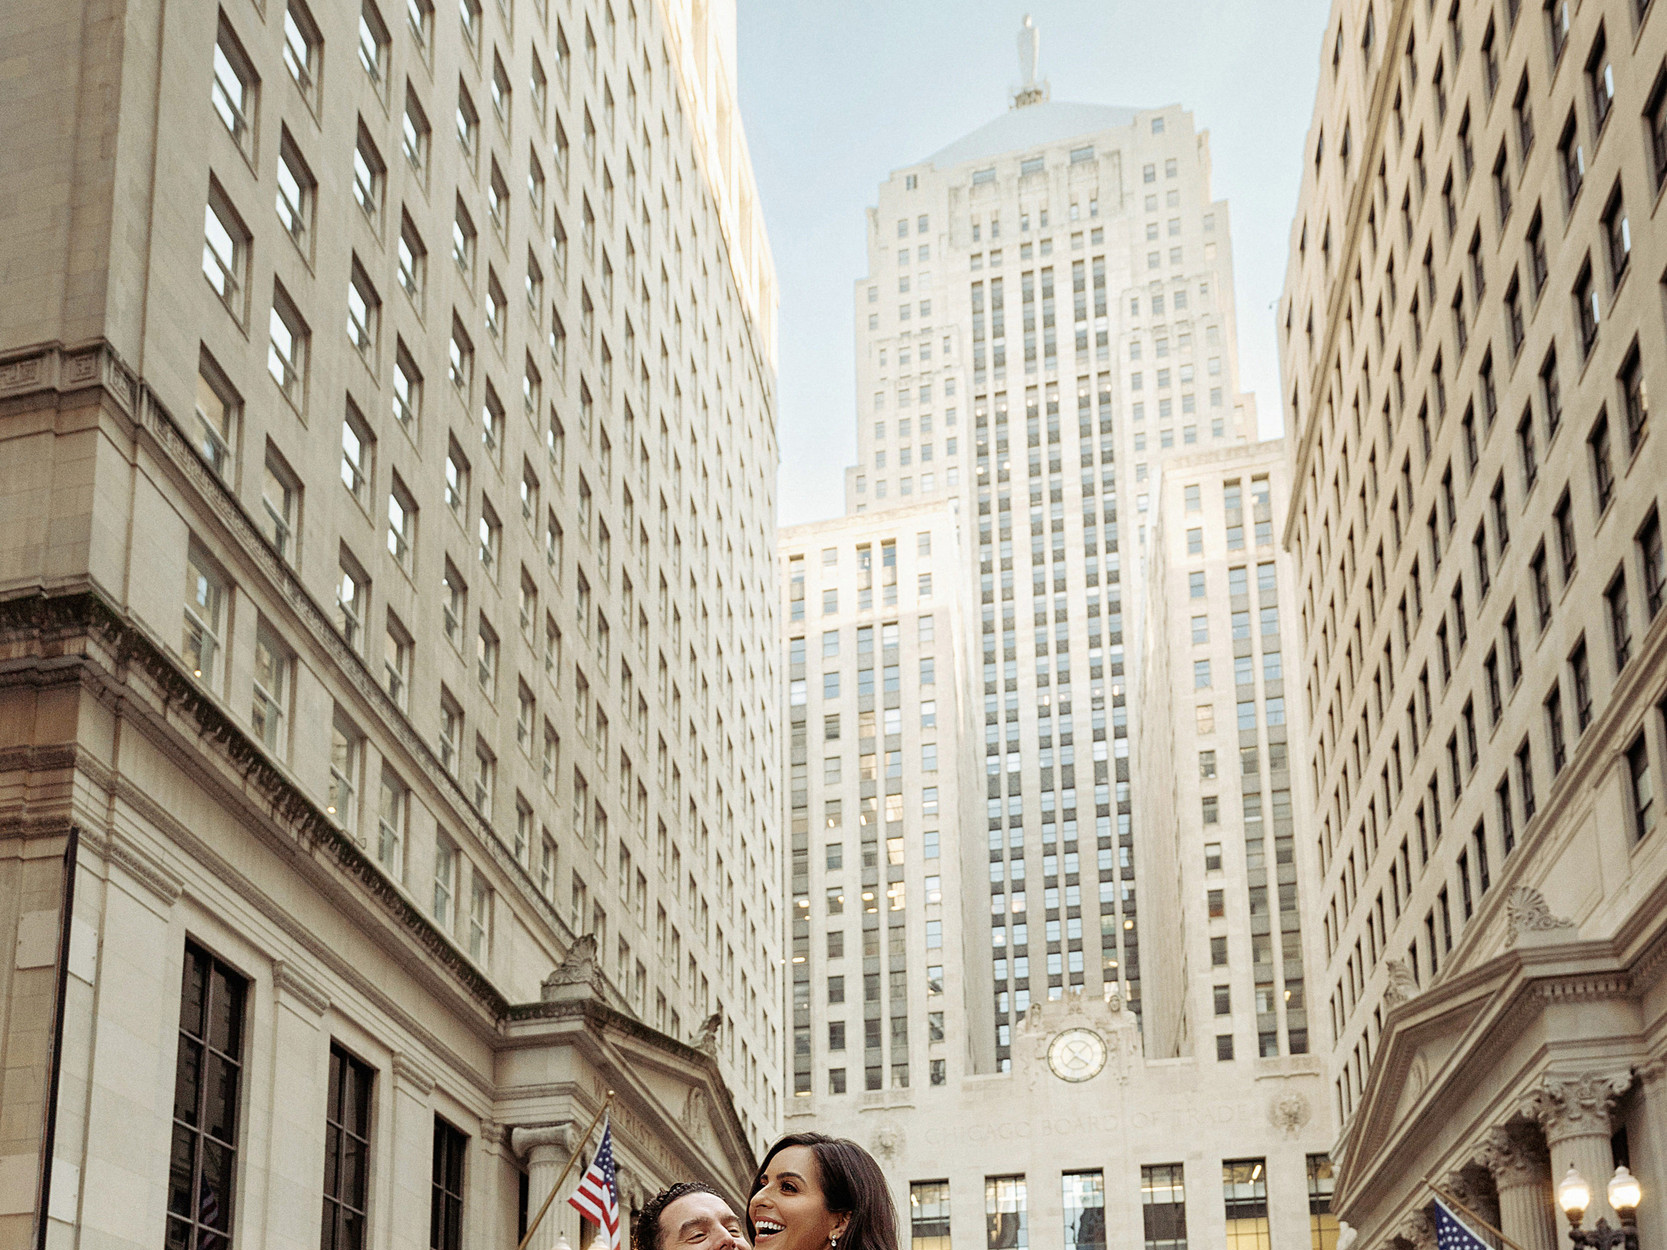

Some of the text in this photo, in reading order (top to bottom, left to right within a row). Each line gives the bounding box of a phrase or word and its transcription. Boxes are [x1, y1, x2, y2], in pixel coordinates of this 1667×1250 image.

[924, 1104, 1250, 1145] CHICAGO BOARD OF TRADE
